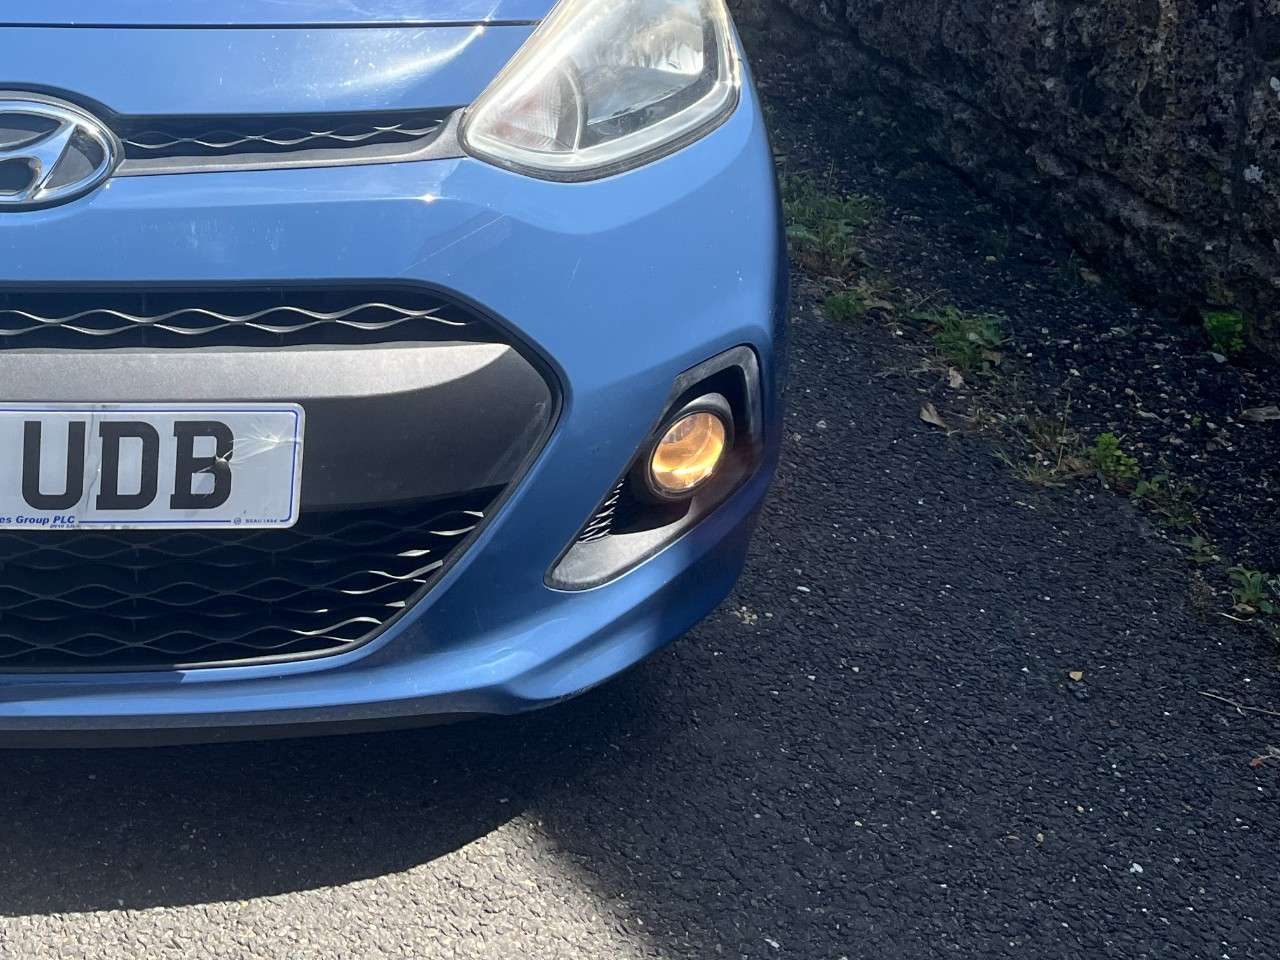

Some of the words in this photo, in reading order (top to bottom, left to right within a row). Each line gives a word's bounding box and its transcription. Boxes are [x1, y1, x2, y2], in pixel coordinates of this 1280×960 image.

[21, 419, 234, 511] UDB
[15, 515, 50, 526] Group
[52, 515, 76, 524] PLC
